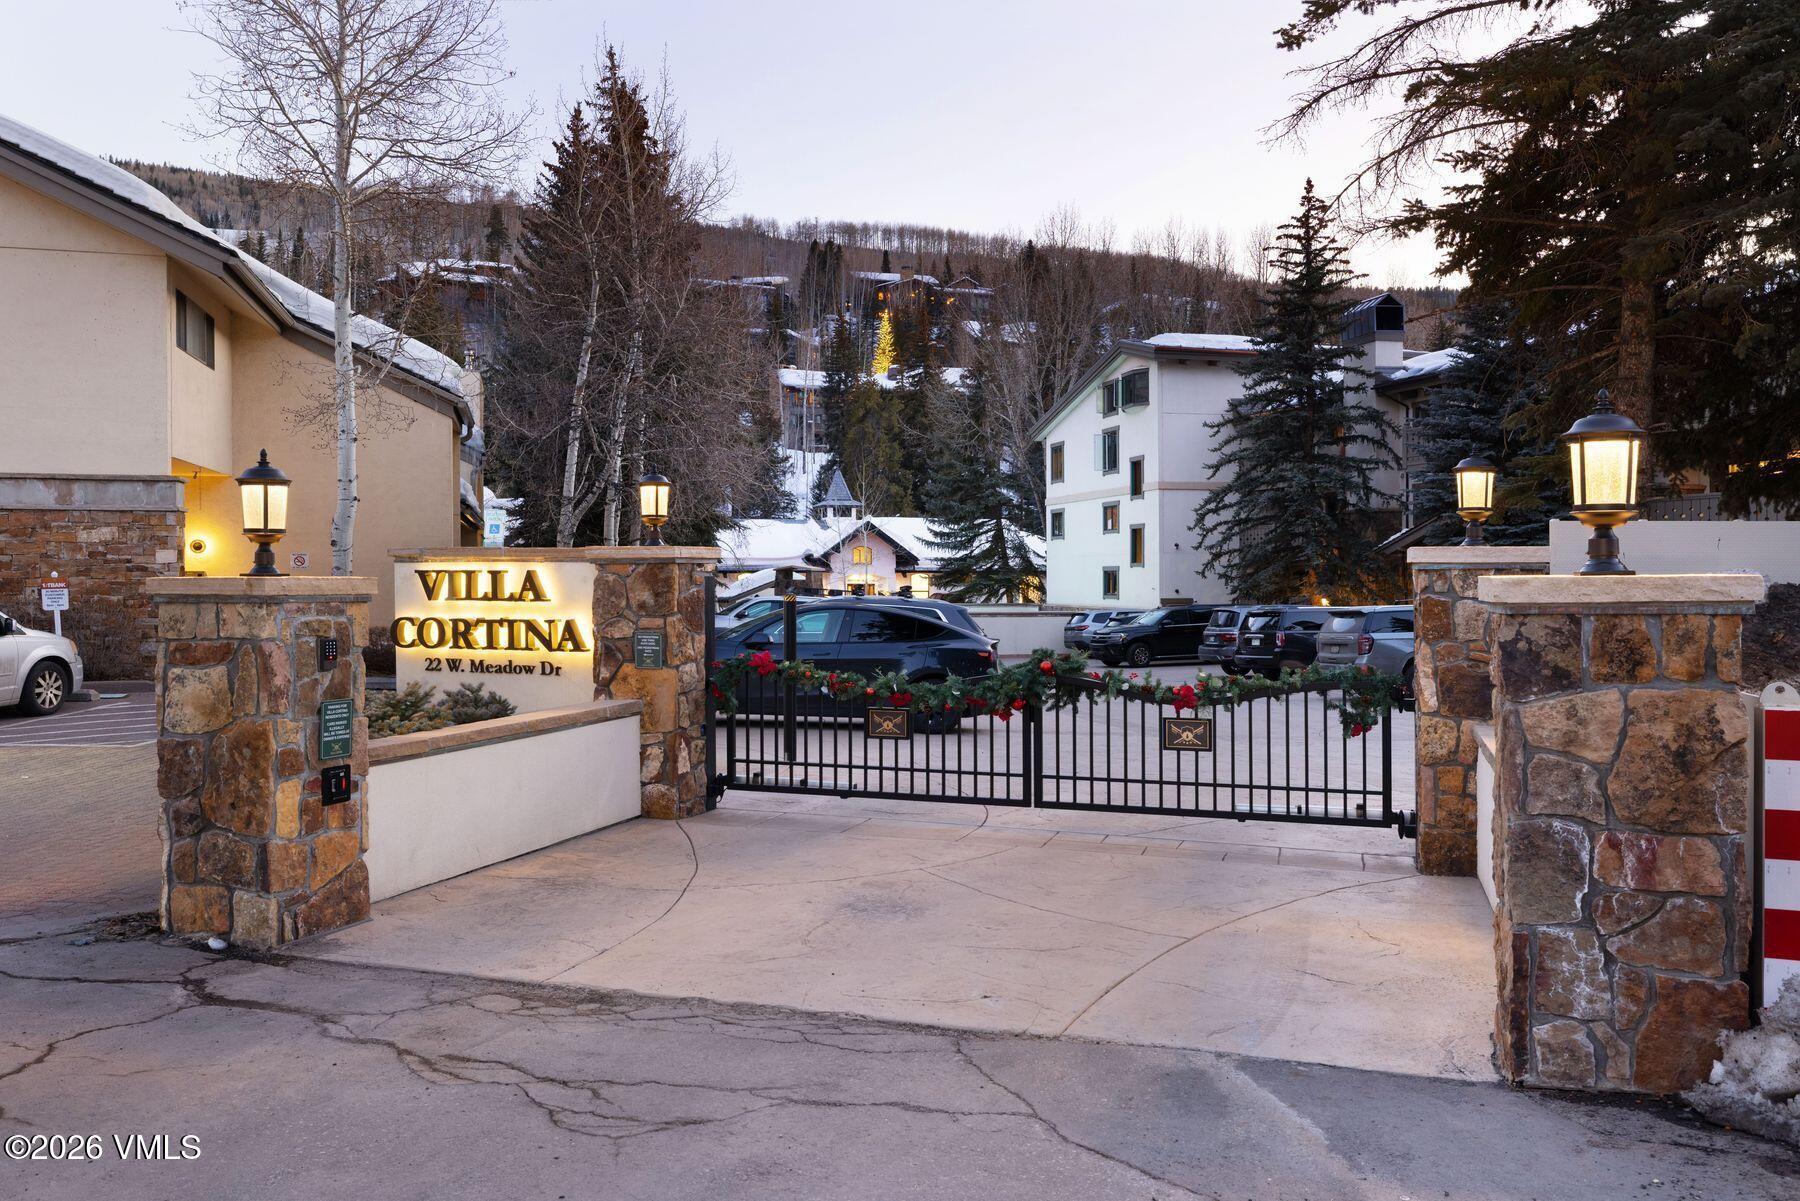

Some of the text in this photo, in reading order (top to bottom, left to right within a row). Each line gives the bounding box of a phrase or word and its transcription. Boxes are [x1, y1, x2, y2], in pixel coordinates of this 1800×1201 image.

[415, 569, 551, 602] VILLA
[390, 616, 590, 652] CORTINA
[424, 658, 562, 676] 22 W. Meadow Dr
